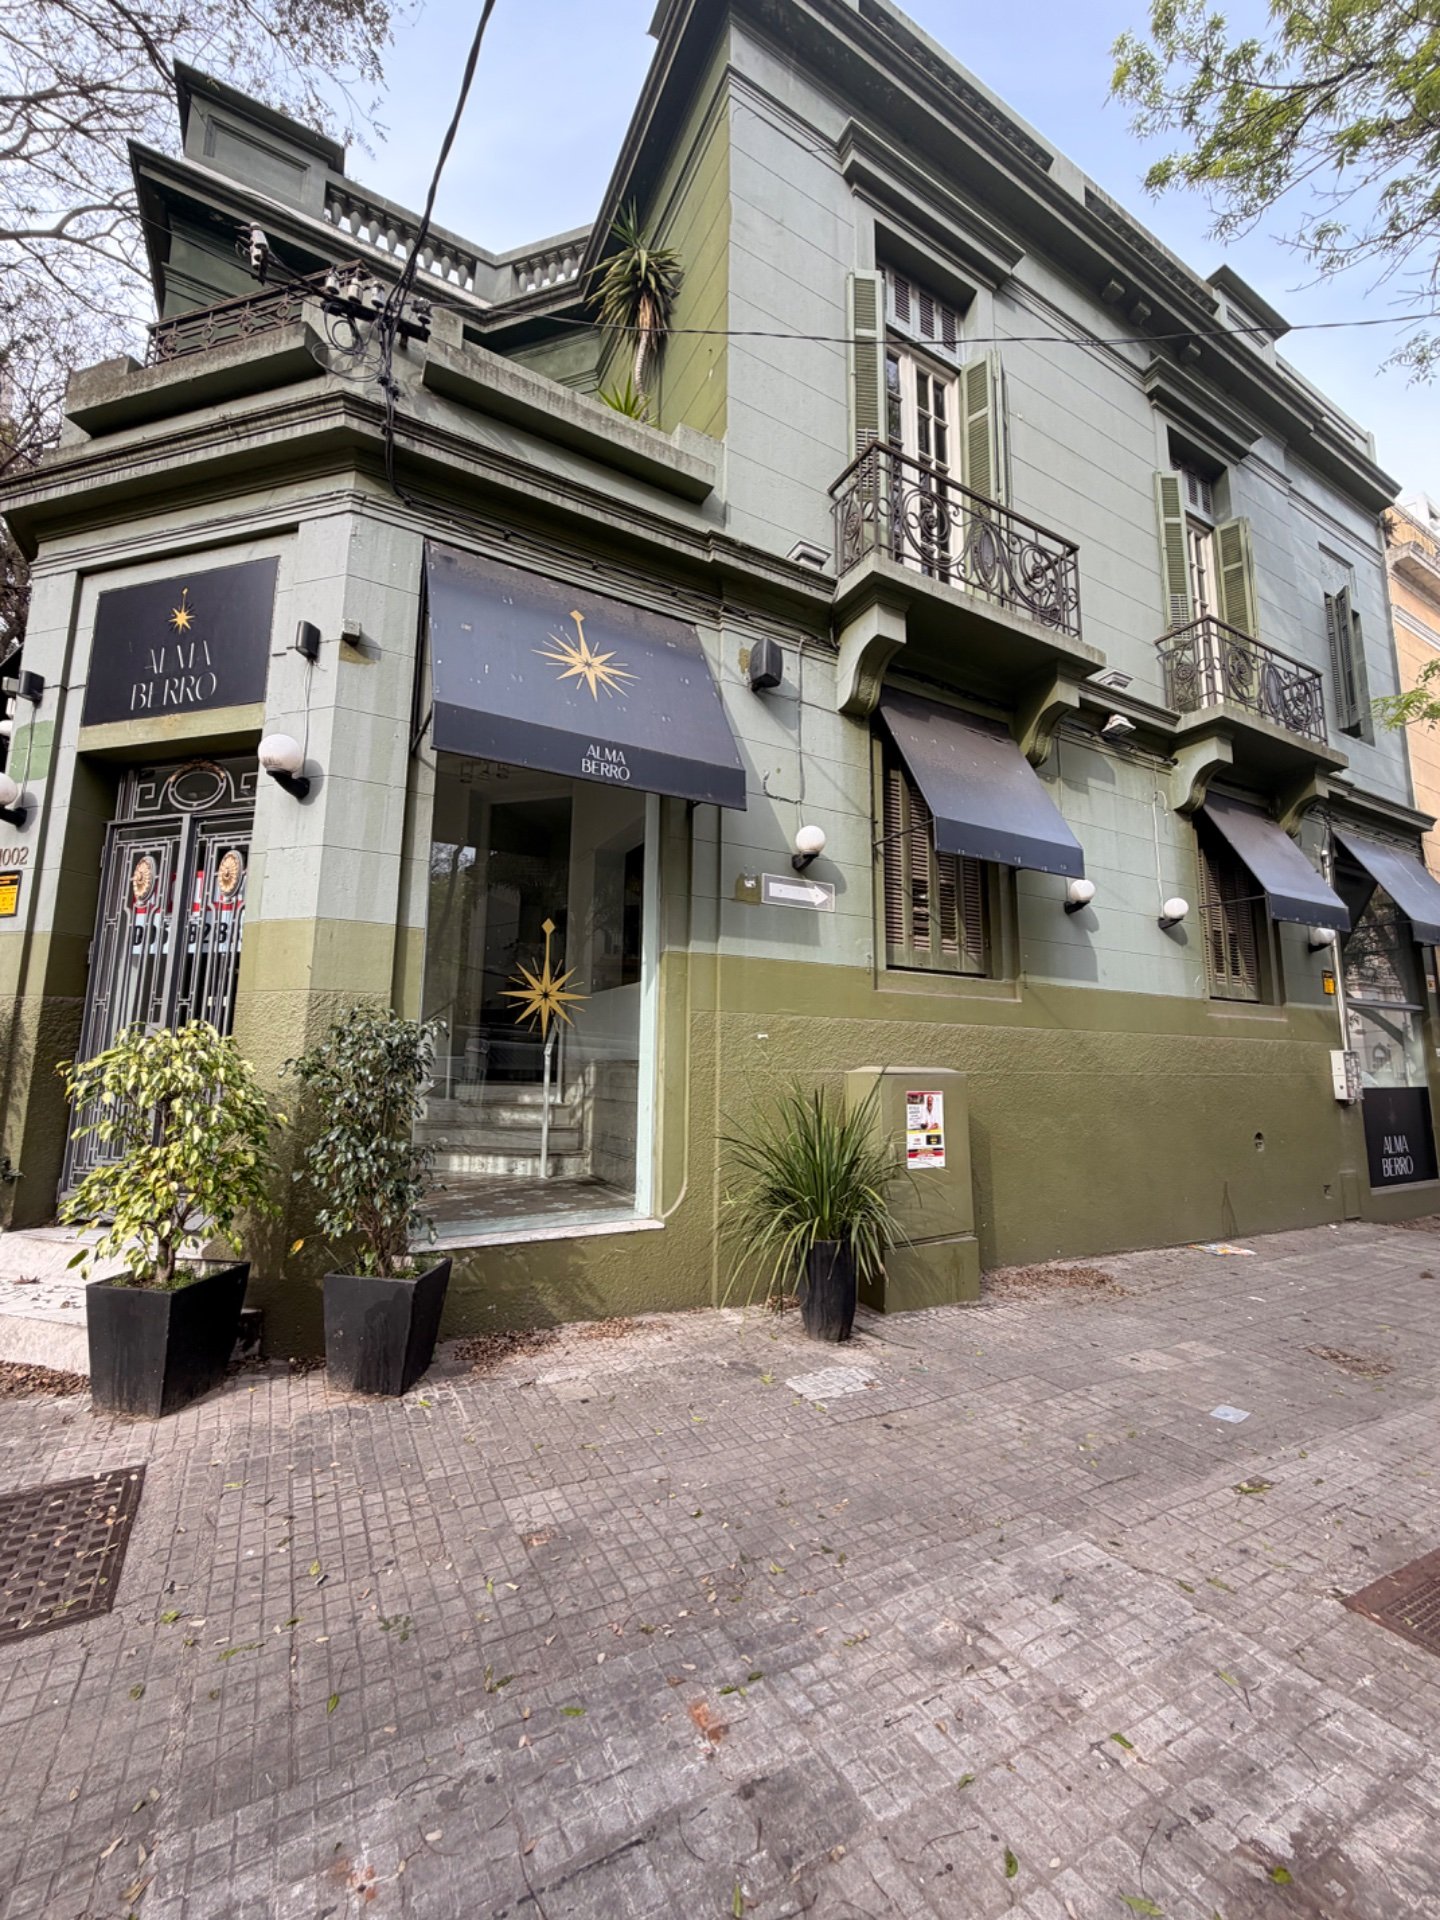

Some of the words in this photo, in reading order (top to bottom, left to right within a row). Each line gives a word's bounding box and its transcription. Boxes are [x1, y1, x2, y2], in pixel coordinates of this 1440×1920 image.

[586, 744, 626, 765] ALMA
[581, 758, 631, 781] BERRO
[1383, 1134, 1410, 1154] ALMA
[1381, 1154, 1414, 1178] BERRO
